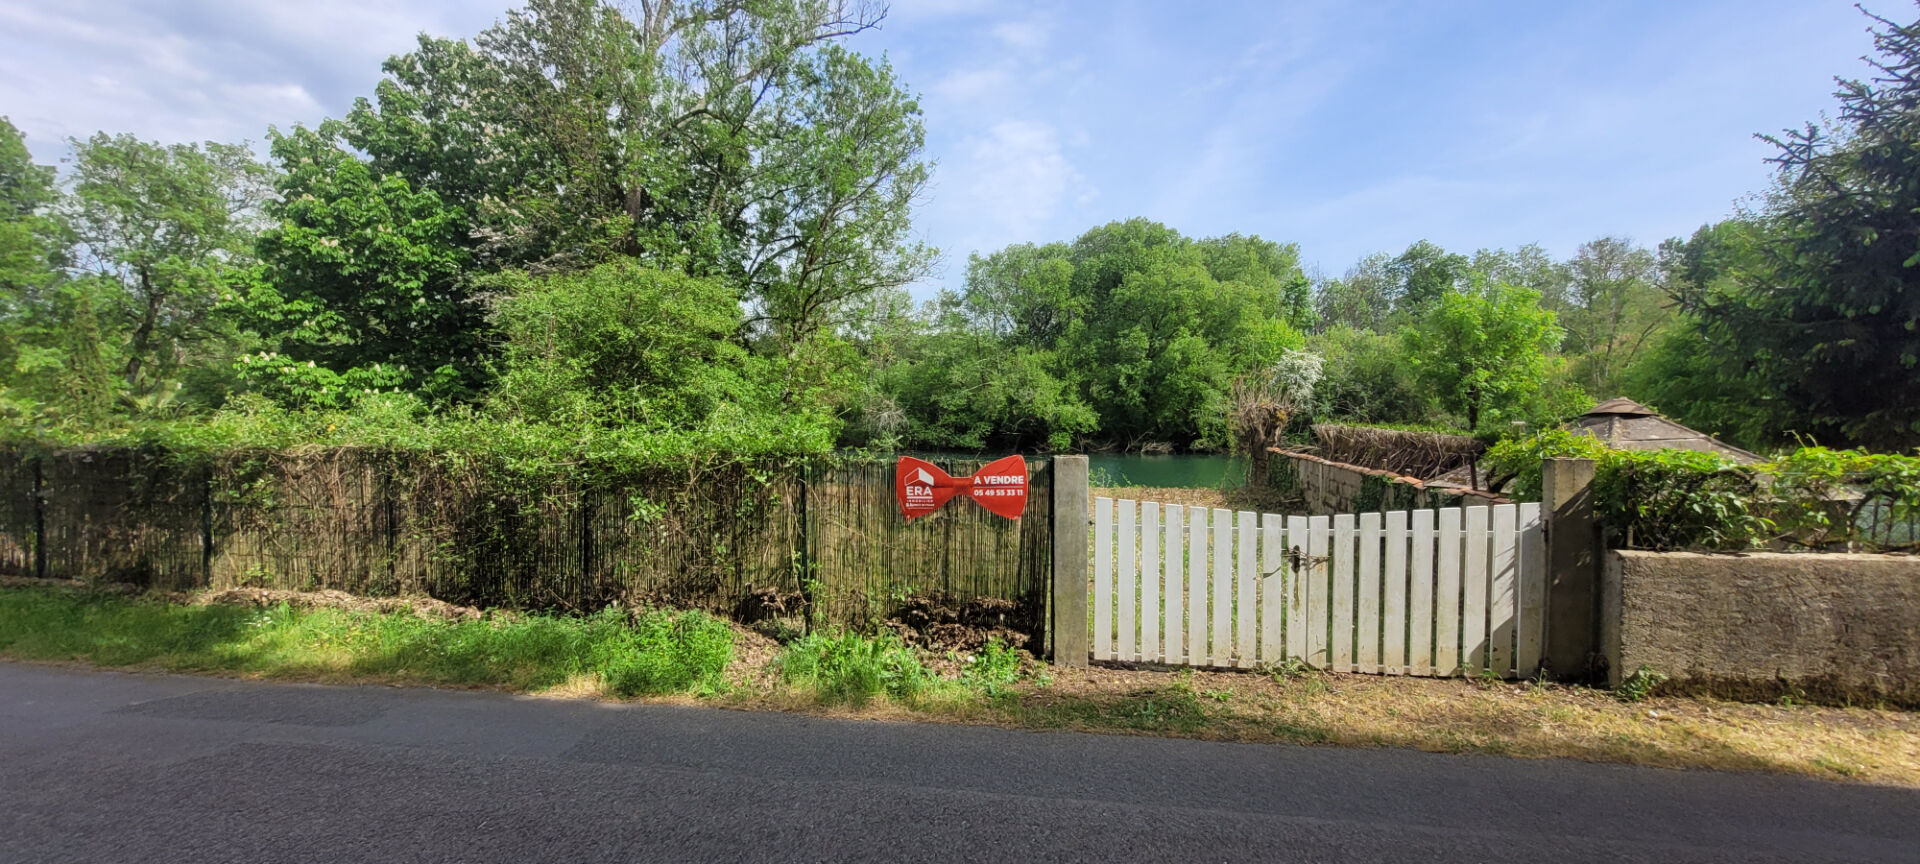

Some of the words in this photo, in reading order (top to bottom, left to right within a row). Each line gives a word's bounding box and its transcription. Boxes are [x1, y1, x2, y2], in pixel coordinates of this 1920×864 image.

[974, 476, 982, 484] A
[983, 475, 1024, 484] VENDRE
[906, 486, 933, 496] ERA
